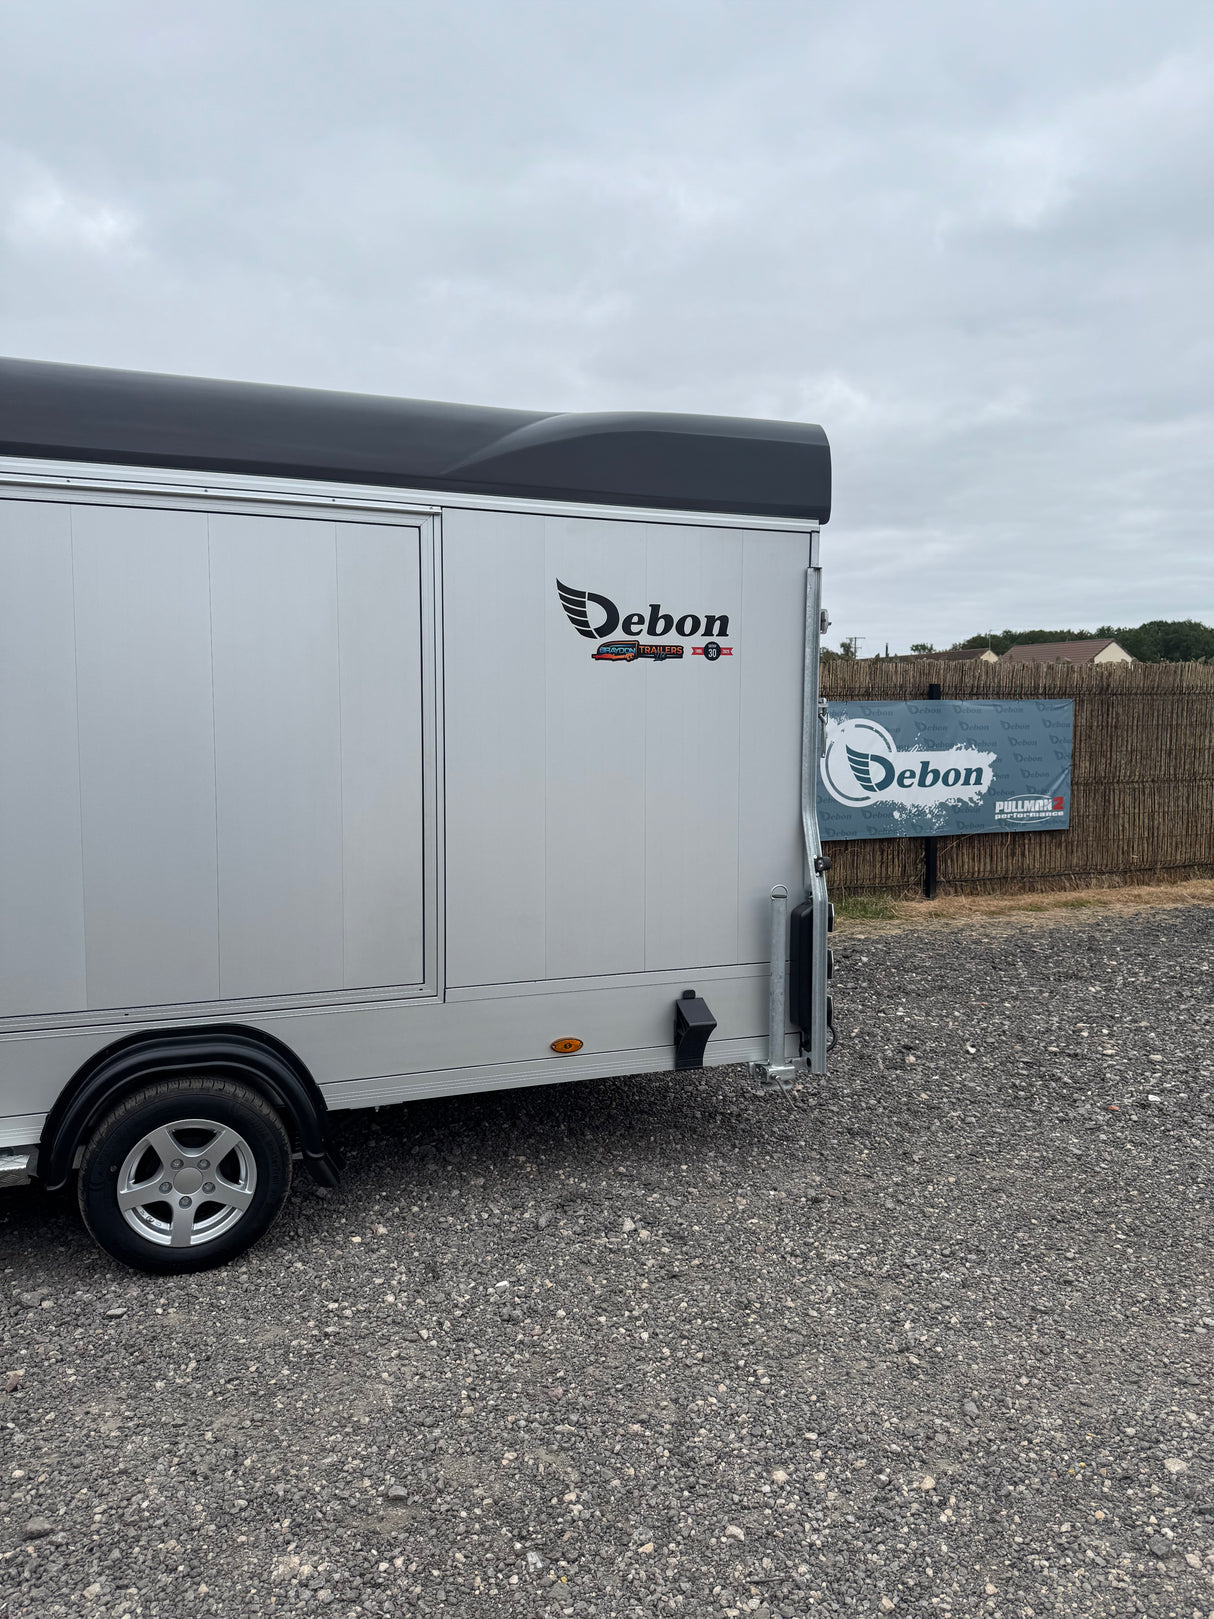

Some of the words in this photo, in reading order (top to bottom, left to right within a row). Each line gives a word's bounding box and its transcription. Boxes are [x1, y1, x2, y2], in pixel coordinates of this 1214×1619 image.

[556, 577, 730, 639] Debon
[639, 646, 683, 655] TRAILERS
[708, 648, 717, 658] 30
[905, 703, 942, 714] Debon
[952, 704, 982, 714] Debon
[914, 720, 948, 732] Debon
[958, 720, 990, 731] Debon
[1000, 720, 1031, 730] Debon
[1008, 736, 1038, 746] Debon
[845, 744, 984, 793] Debon
[820, 811, 852, 821] Debon
[994, 811, 1064, 820] performance
[956, 820, 985, 830] Debon
[824, 827, 858, 837] Debon
